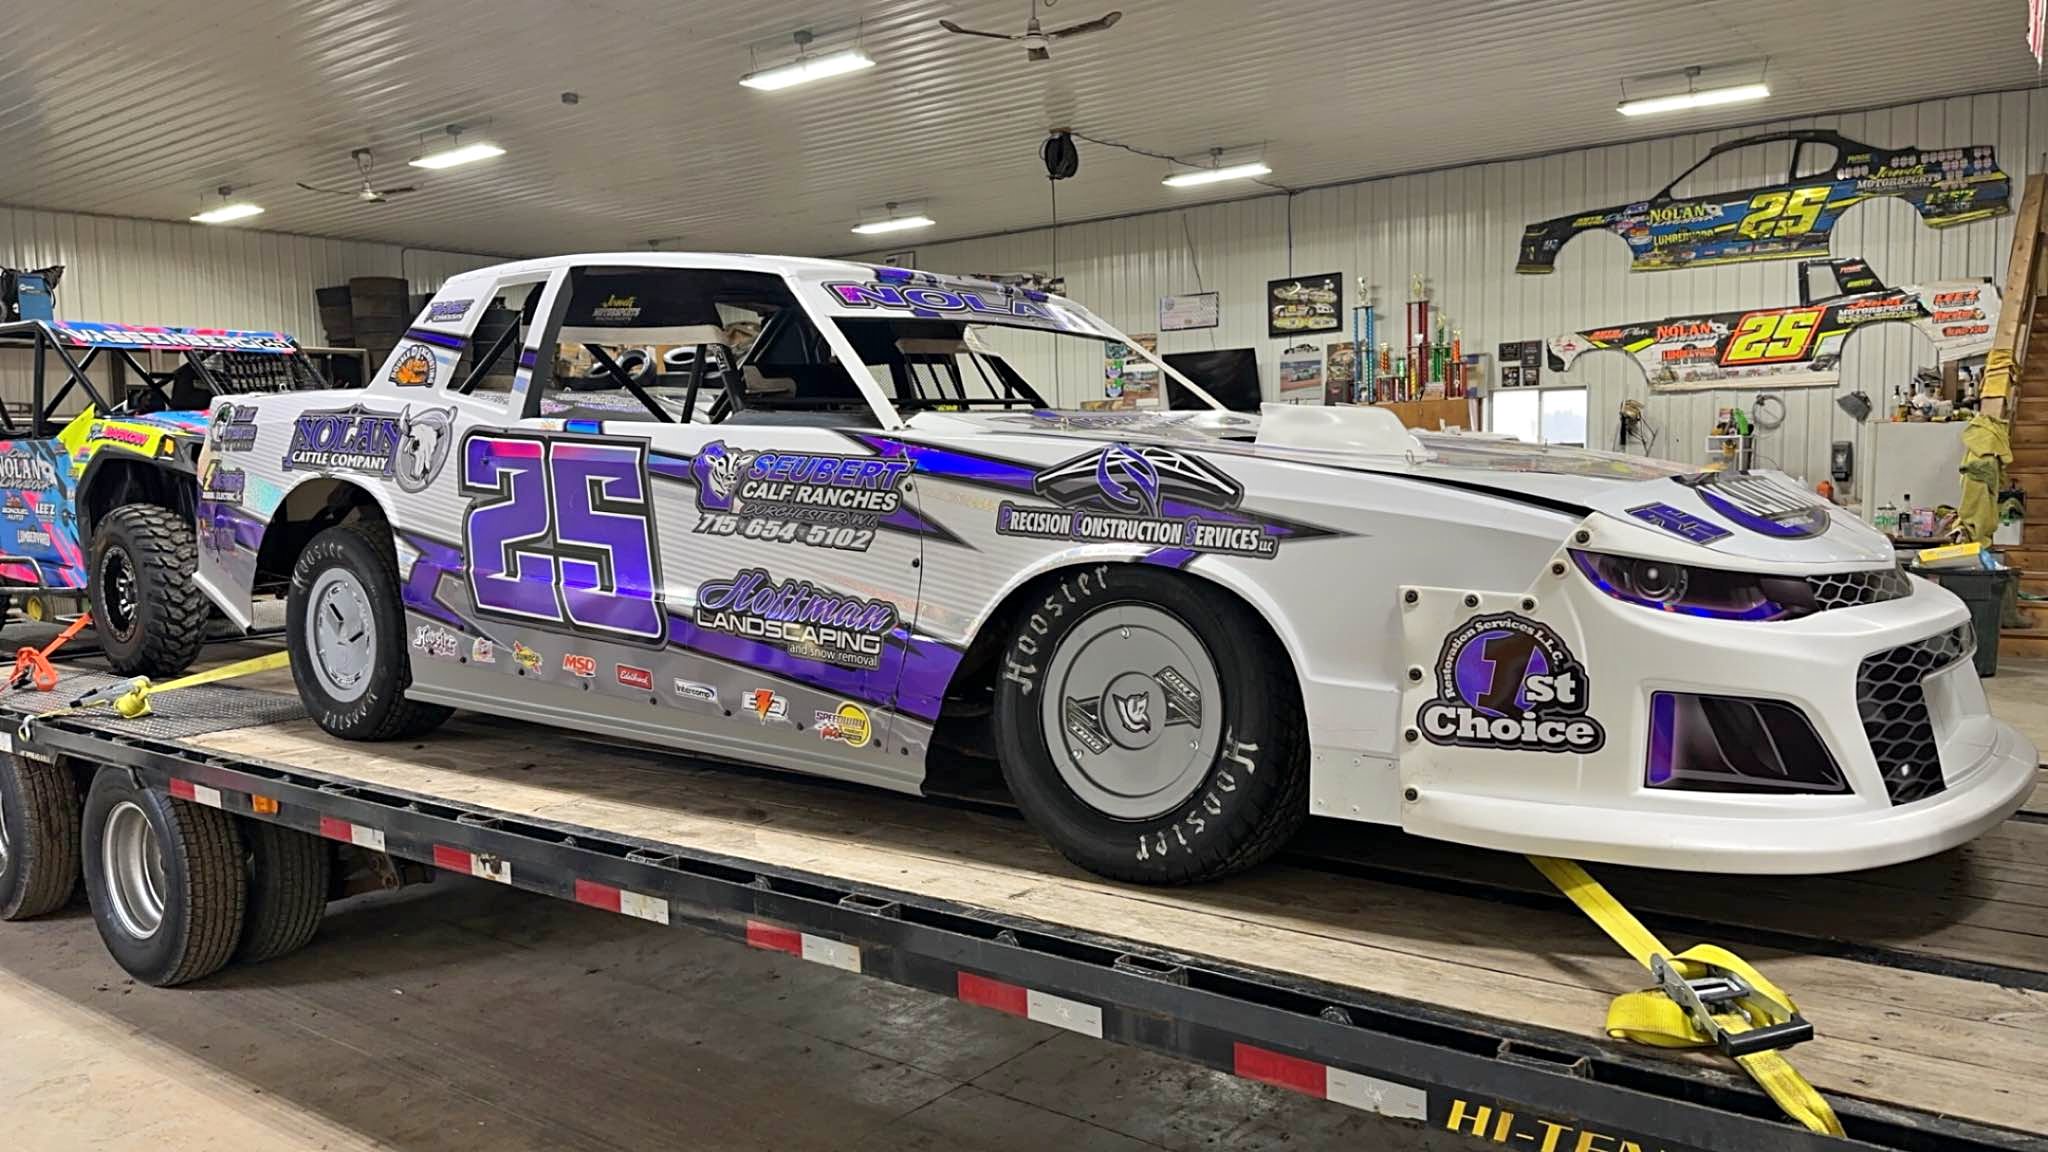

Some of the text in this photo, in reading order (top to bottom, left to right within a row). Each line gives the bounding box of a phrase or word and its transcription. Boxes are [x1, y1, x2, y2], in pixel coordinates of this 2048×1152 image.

[1651, 205, 1707, 224] NOLAN
[1738, 186, 1831, 239] 25
[1657, 323, 1713, 340] NOLAN
[1722, 308, 1826, 363] 25
[294, 414, 402, 456] NOLAN
[292, 450, 389, 470] CATTLE COMPANY
[750, 453, 912, 491] SEUBERT
[742, 481, 898, 511] CALF RANCHES
[461, 431, 666, 643] 25
[699, 513, 873, 550] 715 654 5102
[1001, 507, 1273, 552] PRECISION CONSTRUCTION SERVICES LLC
[700, 572, 897, 634] Hoffman
[697, 610, 882, 654] LANDSCAPING
[1002, 564, 1109, 695] Hoosier
[565, 655, 595, 672] MSD
[789, 643, 878, 667] and snow removal
[1444, 626, 1477, 698] Restoration
[1475, 618, 1536, 636] Services
[1476, 632, 1577, 717] 1st
[675, 683, 712, 699] Intercomp
[1423, 704, 1595, 745] Choice
[1136, 725, 1259, 860] Hoosier
